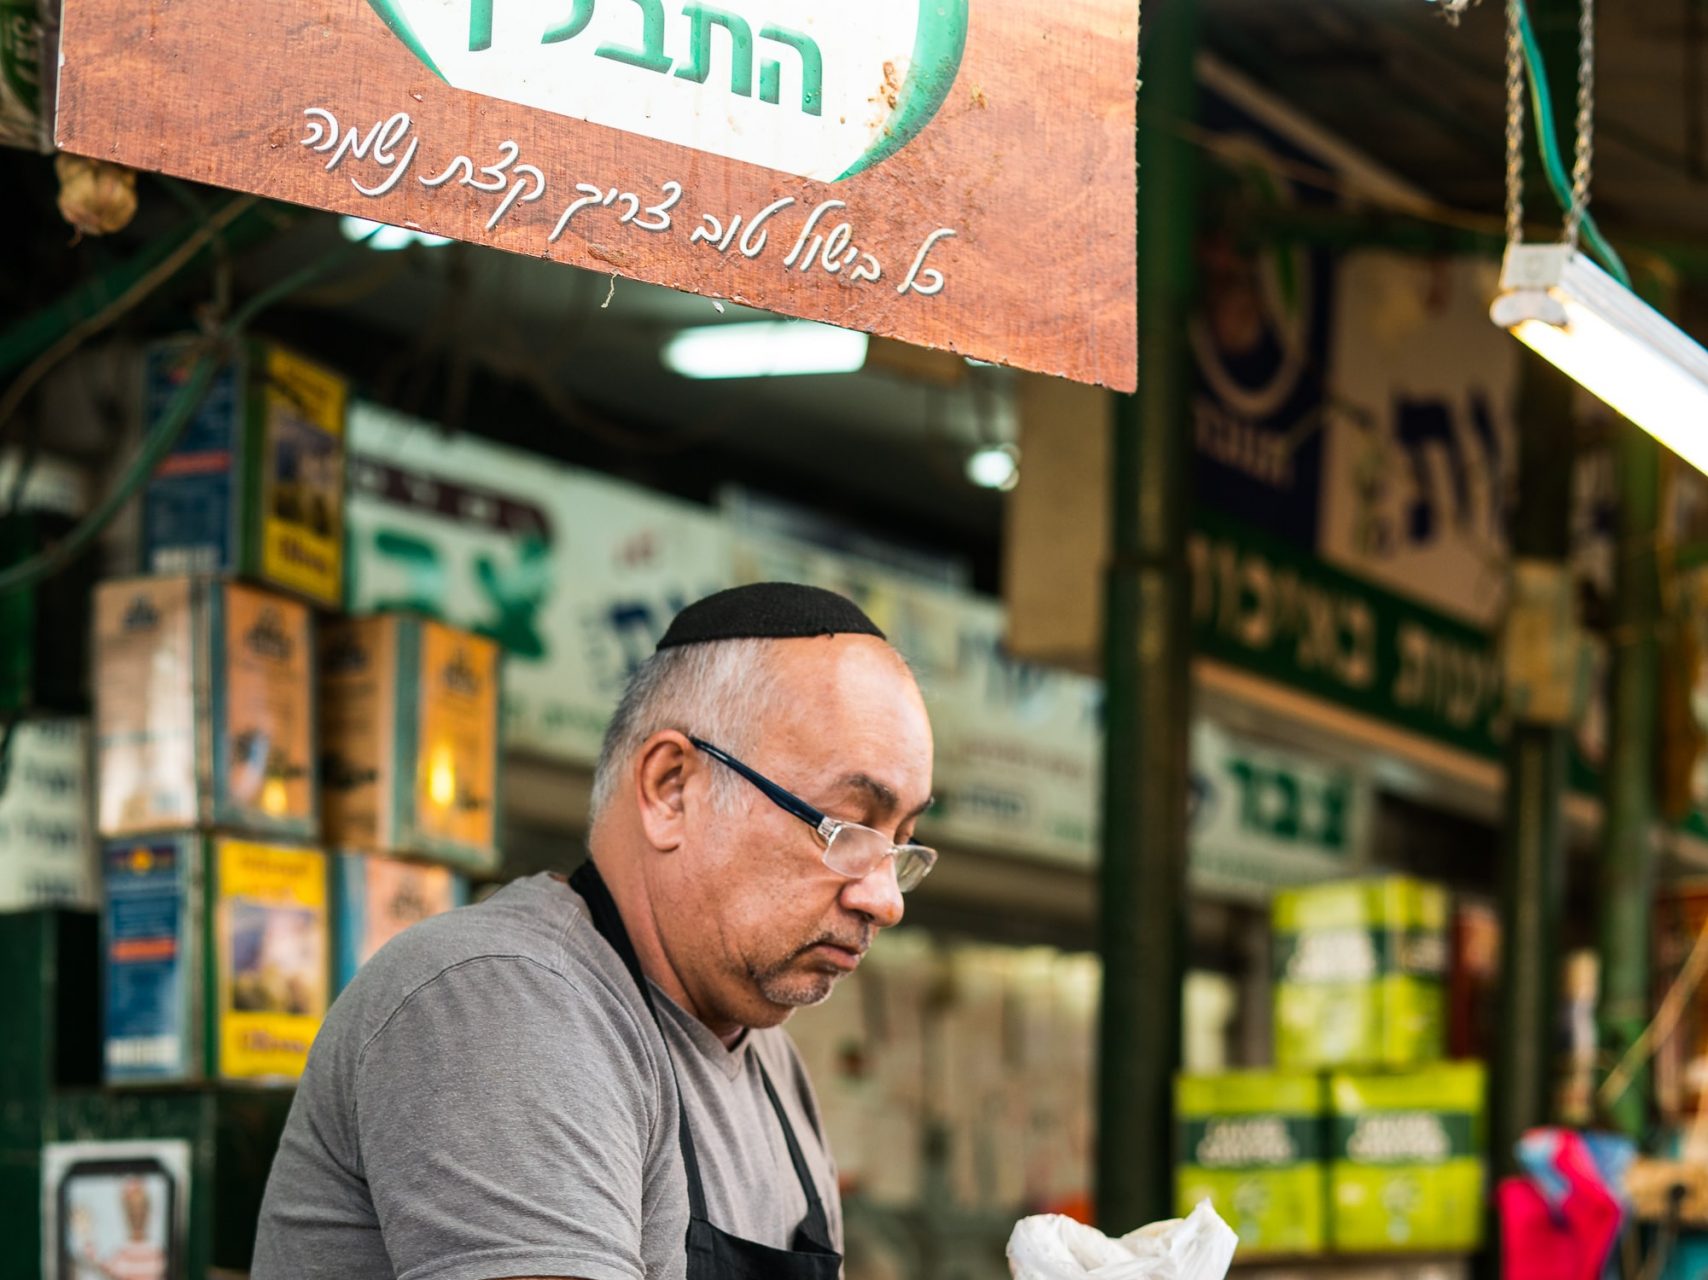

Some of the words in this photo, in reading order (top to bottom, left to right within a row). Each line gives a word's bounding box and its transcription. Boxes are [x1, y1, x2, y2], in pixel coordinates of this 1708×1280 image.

[468, 0, 822, 117] התב
[300, 107, 419, 197] נשמה
[418, 140, 546, 232] קצת
[547, 180, 683, 242] צריך
[690, 196, 795, 258] טוב
[783, 199, 883, 282] בישול
[897, 227, 957, 295] כל
